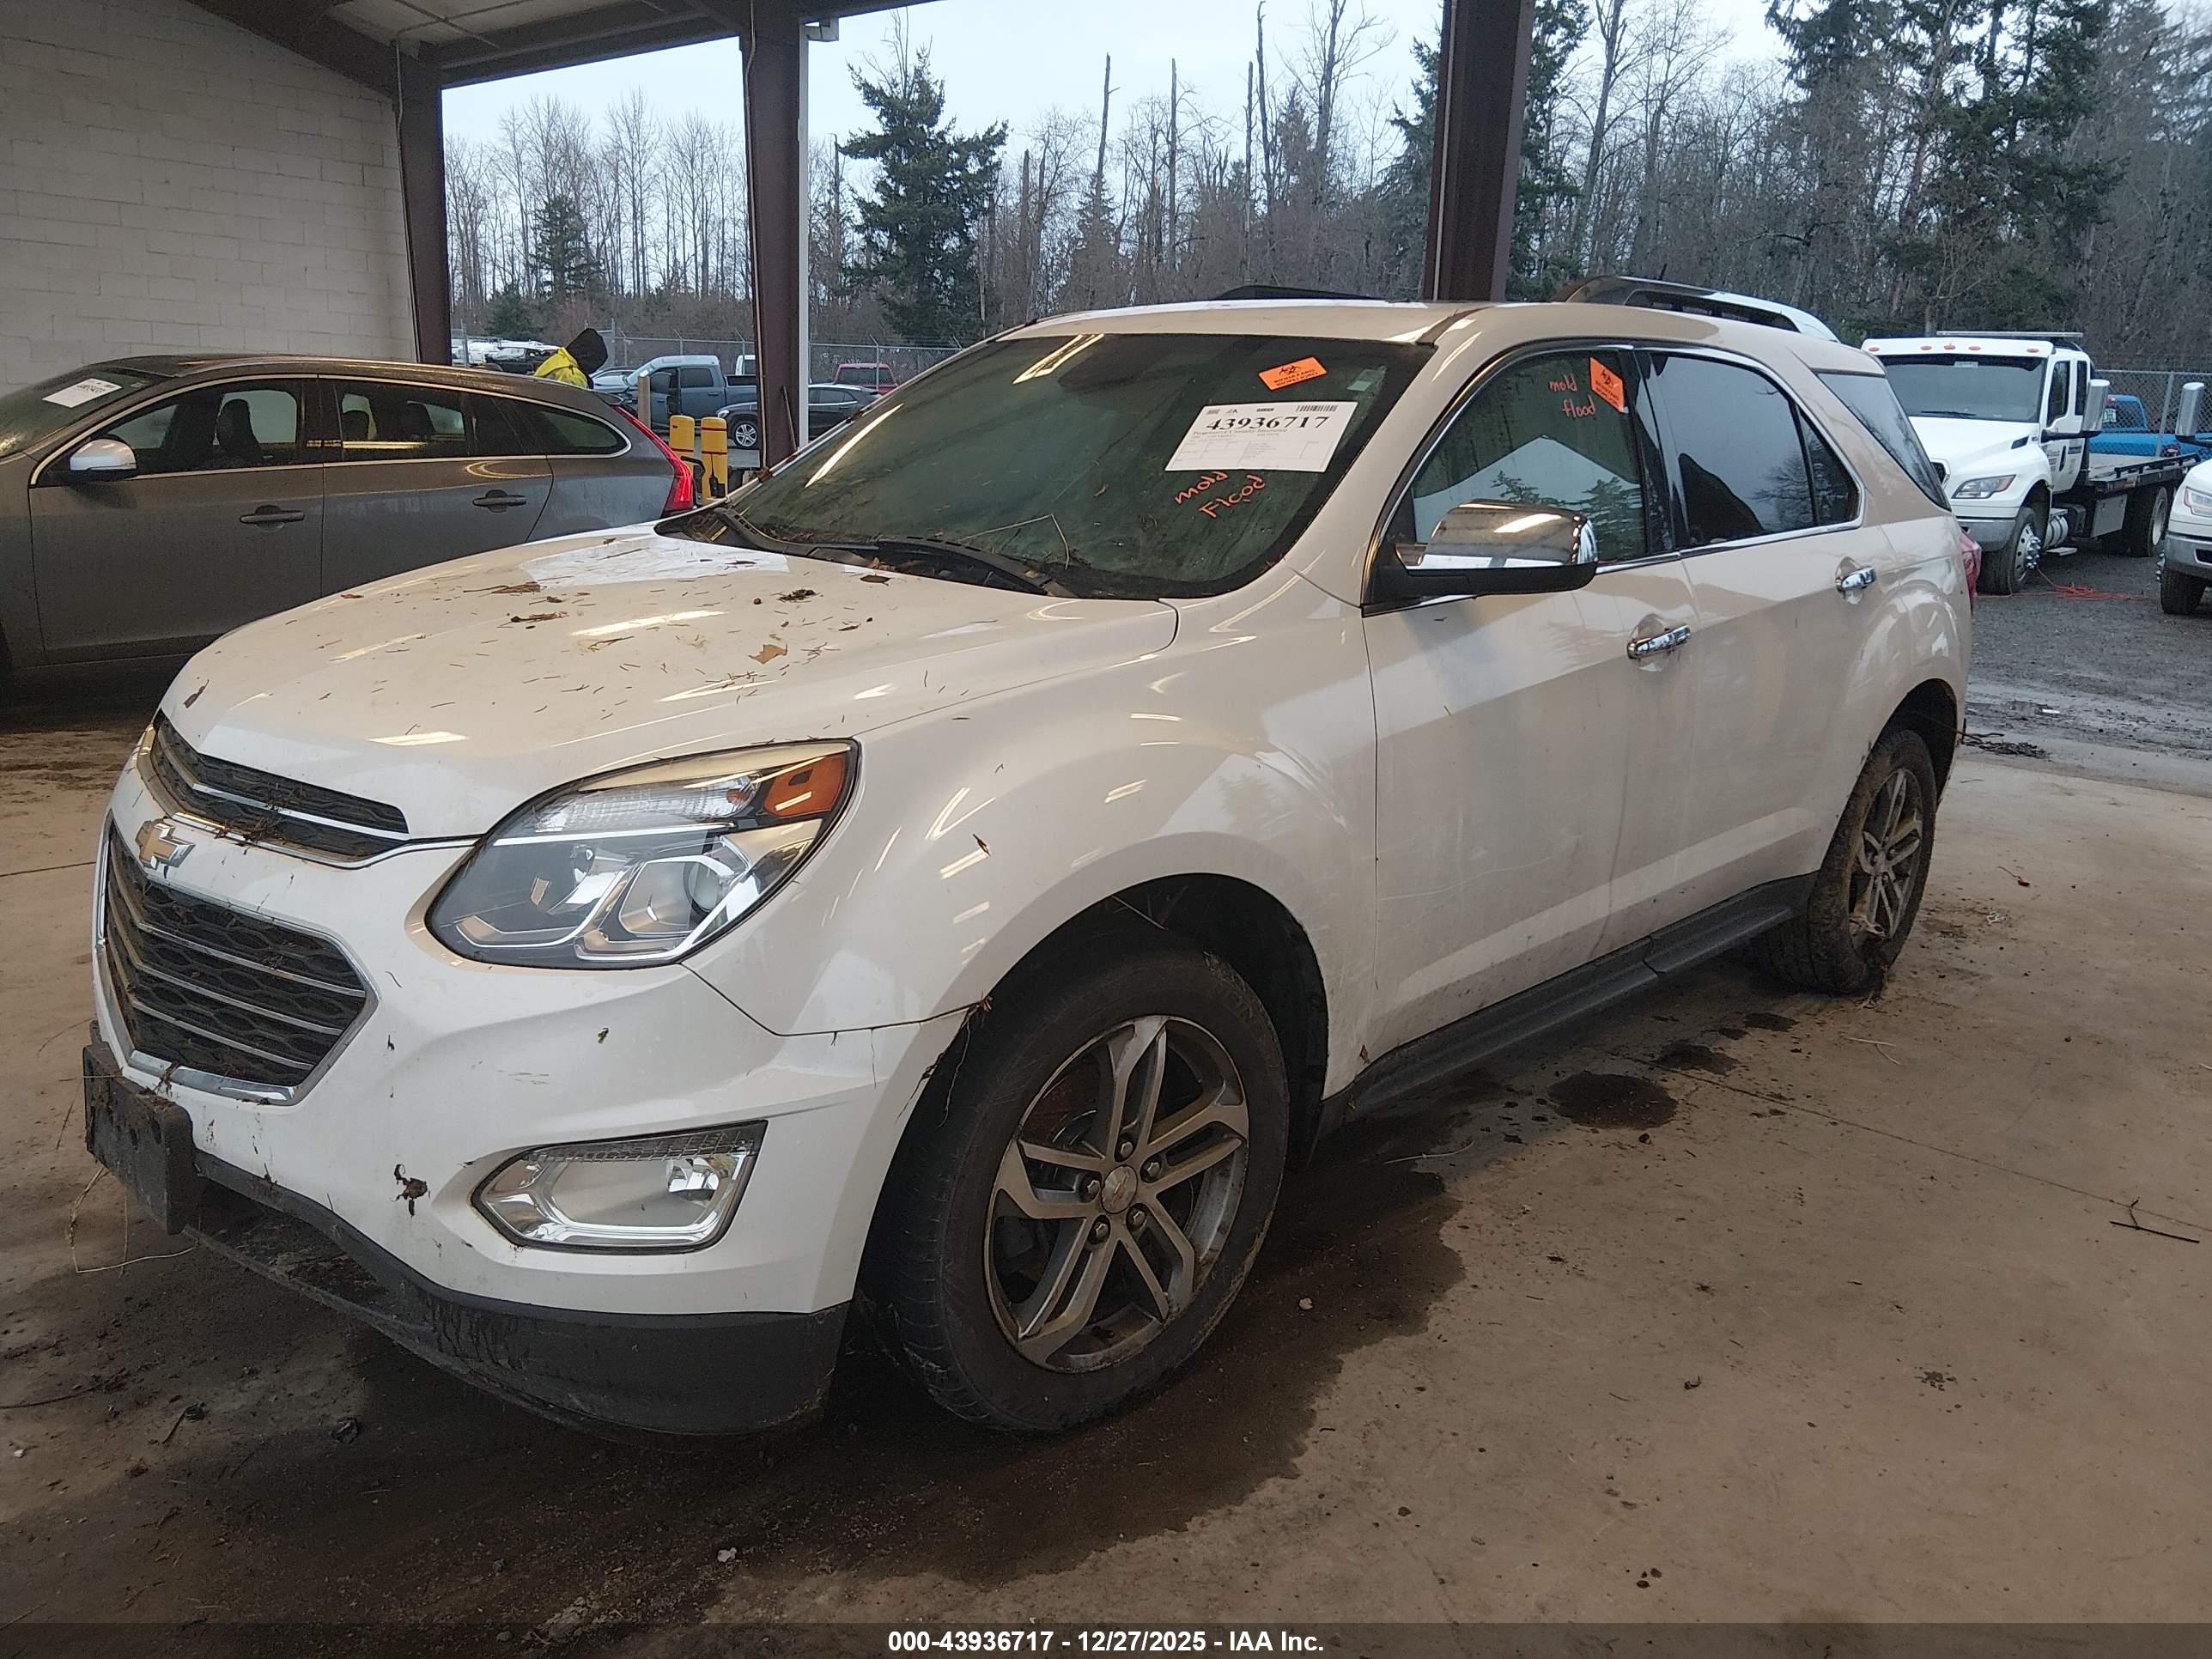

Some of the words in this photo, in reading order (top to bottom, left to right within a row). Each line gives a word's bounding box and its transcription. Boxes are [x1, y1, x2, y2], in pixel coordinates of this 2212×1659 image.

[1549, 374, 1577, 392] mold
[1562, 394, 1596, 417] flood
[1206, 416, 1330, 430] 43936717
[1175, 471, 1228, 504] mold
[1198, 474, 1266, 518] Flood
